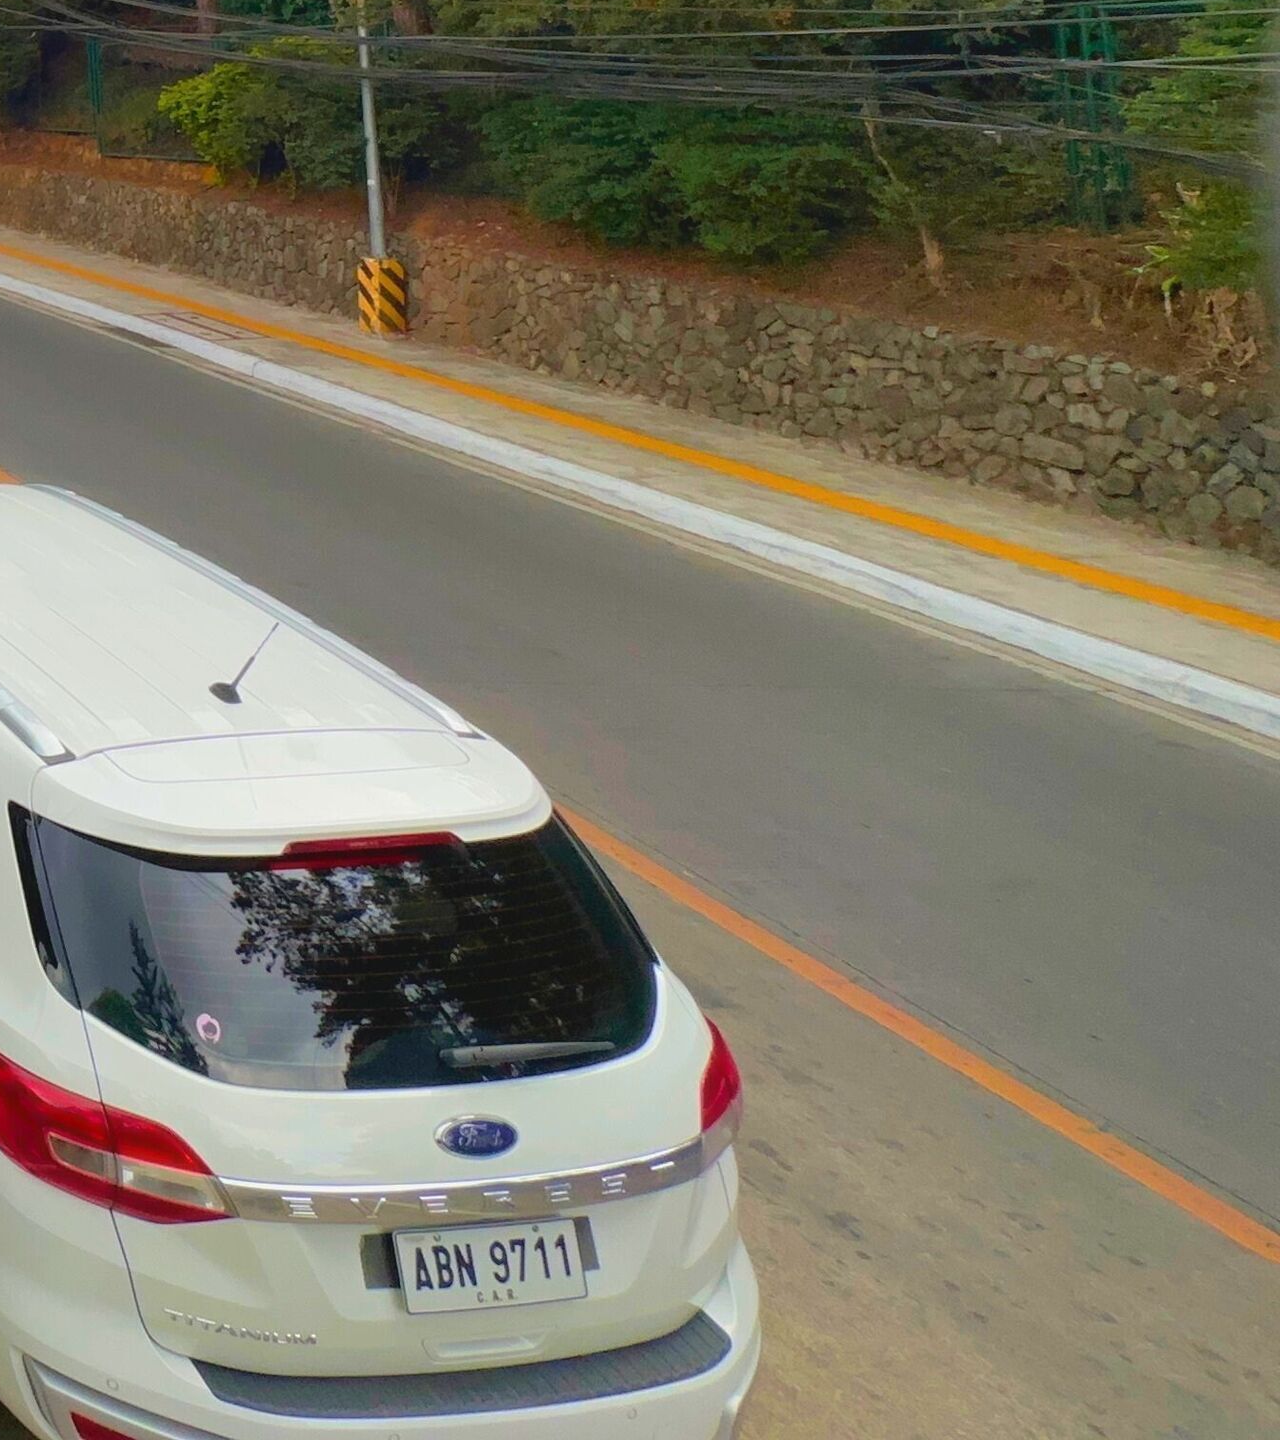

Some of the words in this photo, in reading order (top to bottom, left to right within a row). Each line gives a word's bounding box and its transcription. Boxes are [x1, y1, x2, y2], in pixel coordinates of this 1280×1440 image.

[415, 1243, 478, 1291] ABN
[490, 1233, 572, 1284] 9711
[163, 1308, 317, 1345] TITANIUM
